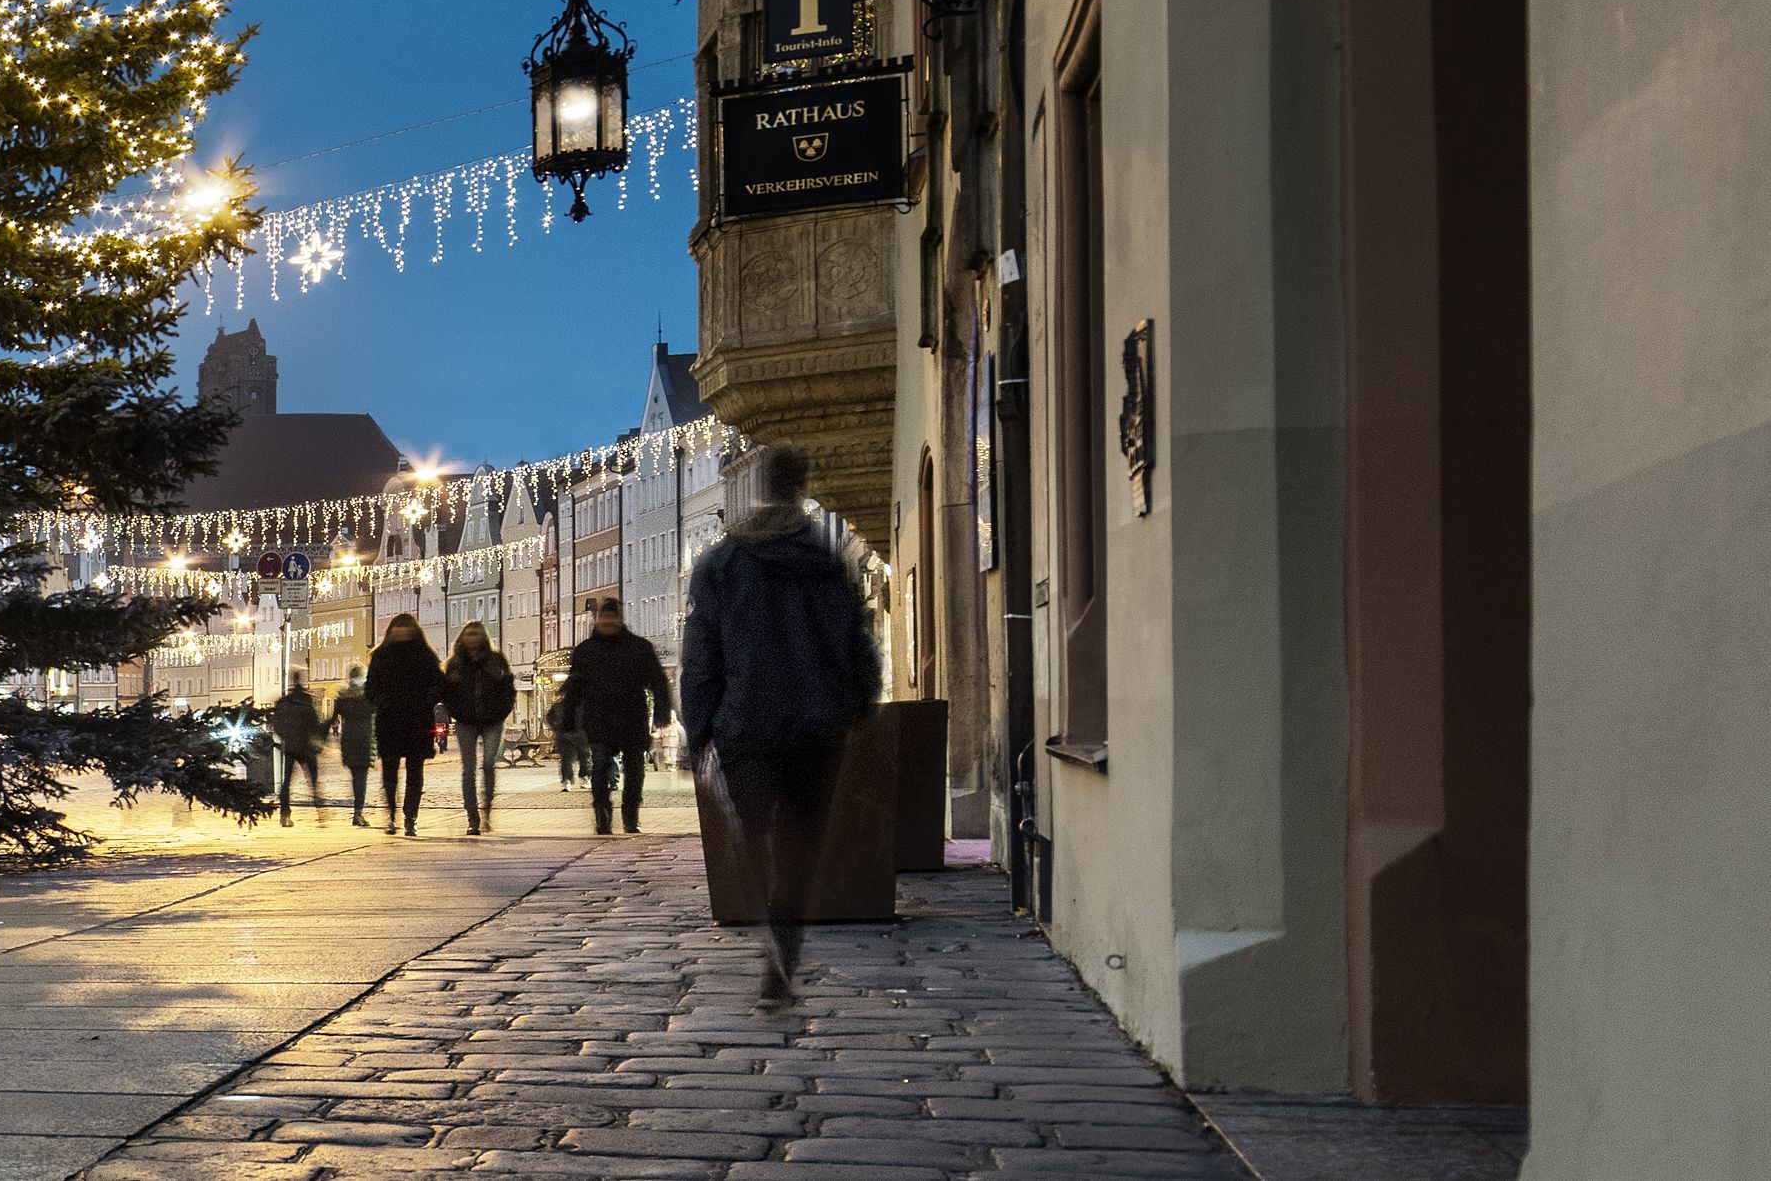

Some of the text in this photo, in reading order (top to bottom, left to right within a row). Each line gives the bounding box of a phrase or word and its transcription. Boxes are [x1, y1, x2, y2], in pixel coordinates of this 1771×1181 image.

[774, 36, 843, 53] Tourist-Info
[755, 100, 865, 130] RATHAUS
[745, 171, 879, 196] VERKEHRSVEREIN
